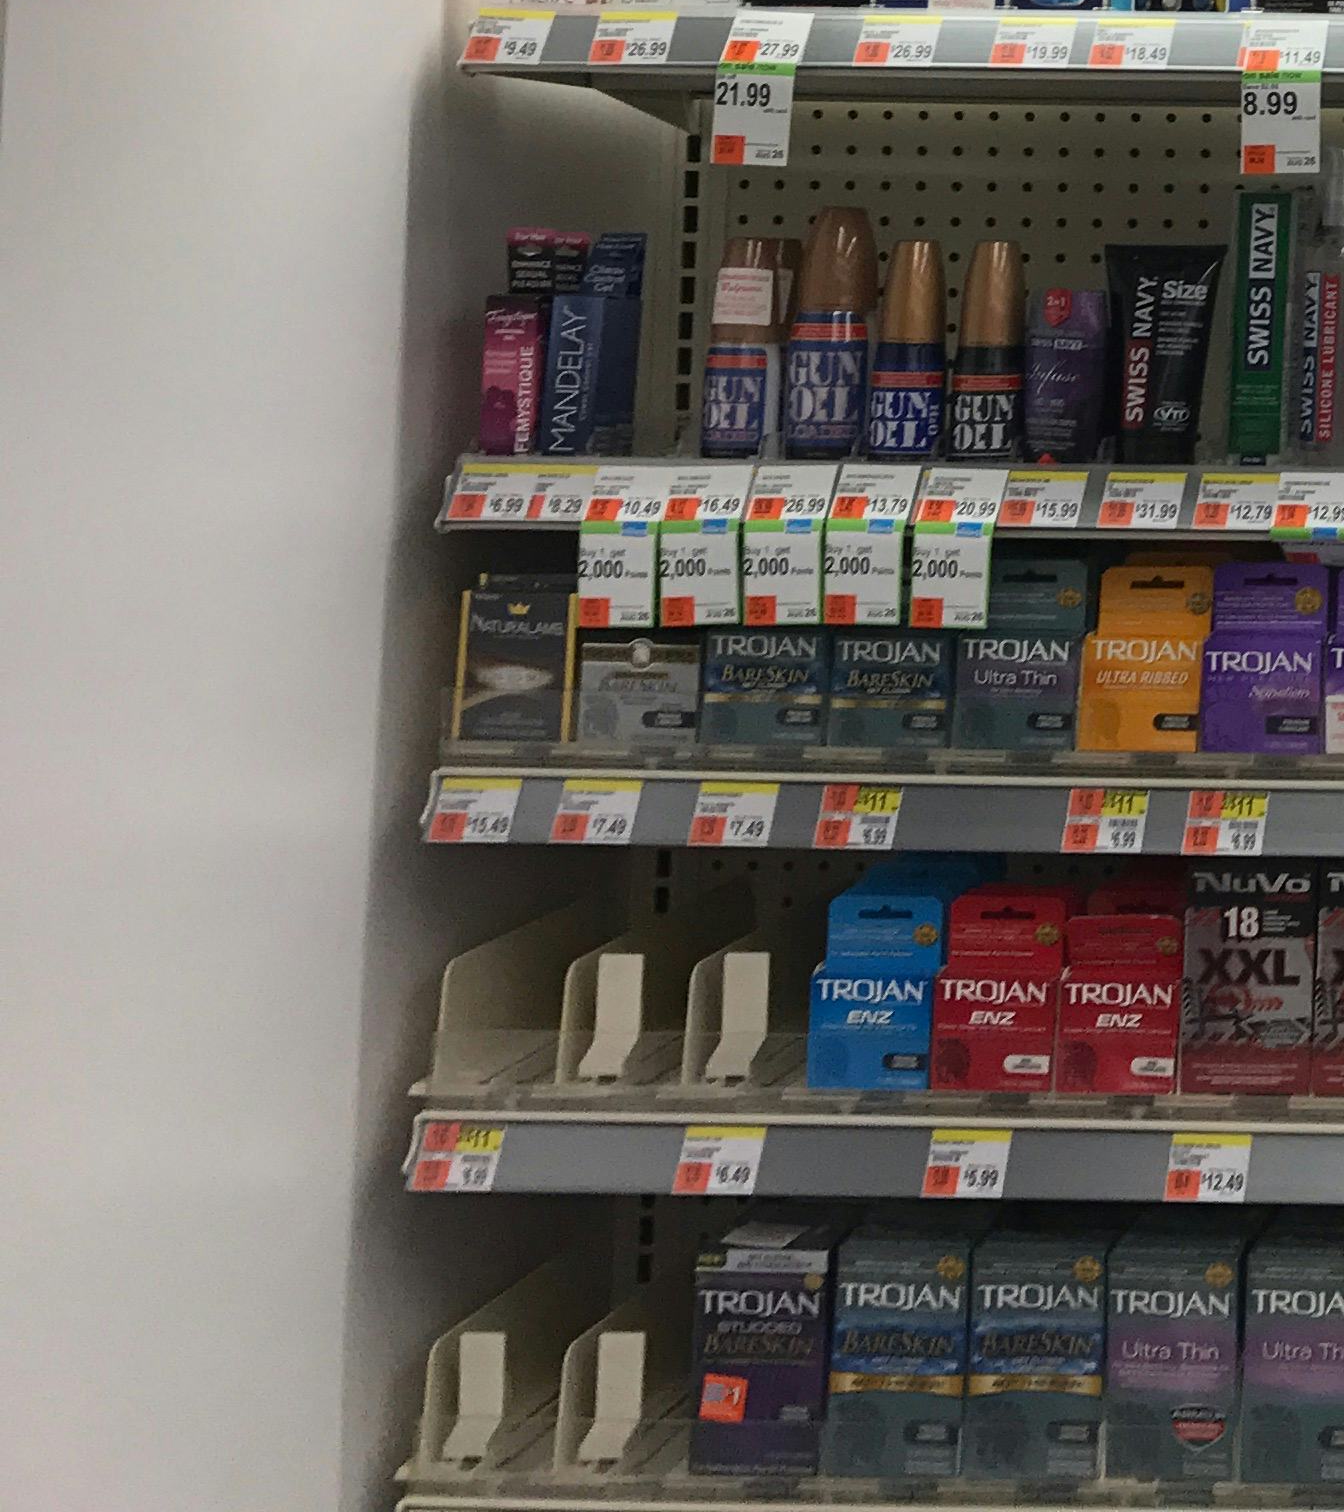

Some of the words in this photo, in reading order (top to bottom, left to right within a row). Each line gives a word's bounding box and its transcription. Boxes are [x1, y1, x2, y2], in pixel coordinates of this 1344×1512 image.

[504, 40, 537, 58] $9.49
[626, 40, 667, 58] $26.99
[1125, 46, 1167, 62] $18.49
[1280, 50, 1321, 65] $11.49
[716, 82, 771, 109] 21.99
[1243, 91, 1298, 116] 8.99
[1252, 207, 1278, 276] NAVY
[1163, 280, 1207, 301] Size
[1133, 277, 1158, 338] NAVY
[1321, 276, 1338, 356] LUBRICANT
[1248, 286, 1270, 368] SWISS
[548, 305, 588, 451] MANDELAY
[790, 351, 862, 386] GUN
[1125, 345, 1149, 422] SWISS
[870, 391, 932, 420] GUN
[954, 394, 1015, 421] GUN
[1318, 360, 1336, 441] SILICONE
[870, 421, 927, 447] OIL
[954, 423, 1013, 450] OIL
[867, 498, 907, 515] $13.79
[1135, 502, 1178, 520] $31.99
[1230, 503, 1273, 522] $12.79
[578, 560, 623, 582] 2,000
[660, 558, 706, 580] 2,000
[744, 557, 790, 579] 2,000
[825, 557, 870, 578] 2,000
[912, 559, 958, 581] 2,000
[712, 635, 818, 659] TROJAN
[838, 640, 942, 664] TROJAN
[963, 639, 1070, 663] TROJAN
[1092, 640, 1198, 662] TROJAN
[1206, 650, 1313, 674] TROJAN
[973, 668, 1015, 686] Ultra
[1020, 668, 1058, 686] Thin
[1224, 908, 1258, 939] 18
[1199, 949, 1300, 985] XXL
[816, 978, 923, 1002] TROJAN
[940, 978, 1047, 1005] TROJAN
[1067, 983, 1173, 1006] TROJAN
[846, 1010, 894, 1025] ENZ
[969, 1012, 1016, 1026] ENZ
[1096, 1012, 1142, 1028] ENZ
[977, 1284, 1099, 1311] TROJAN
[1111, 1291, 1232, 1318] TROJAN
[1122, 1341, 1170, 1361] Ultra
[1175, 1341, 1220, 1361] Thin
